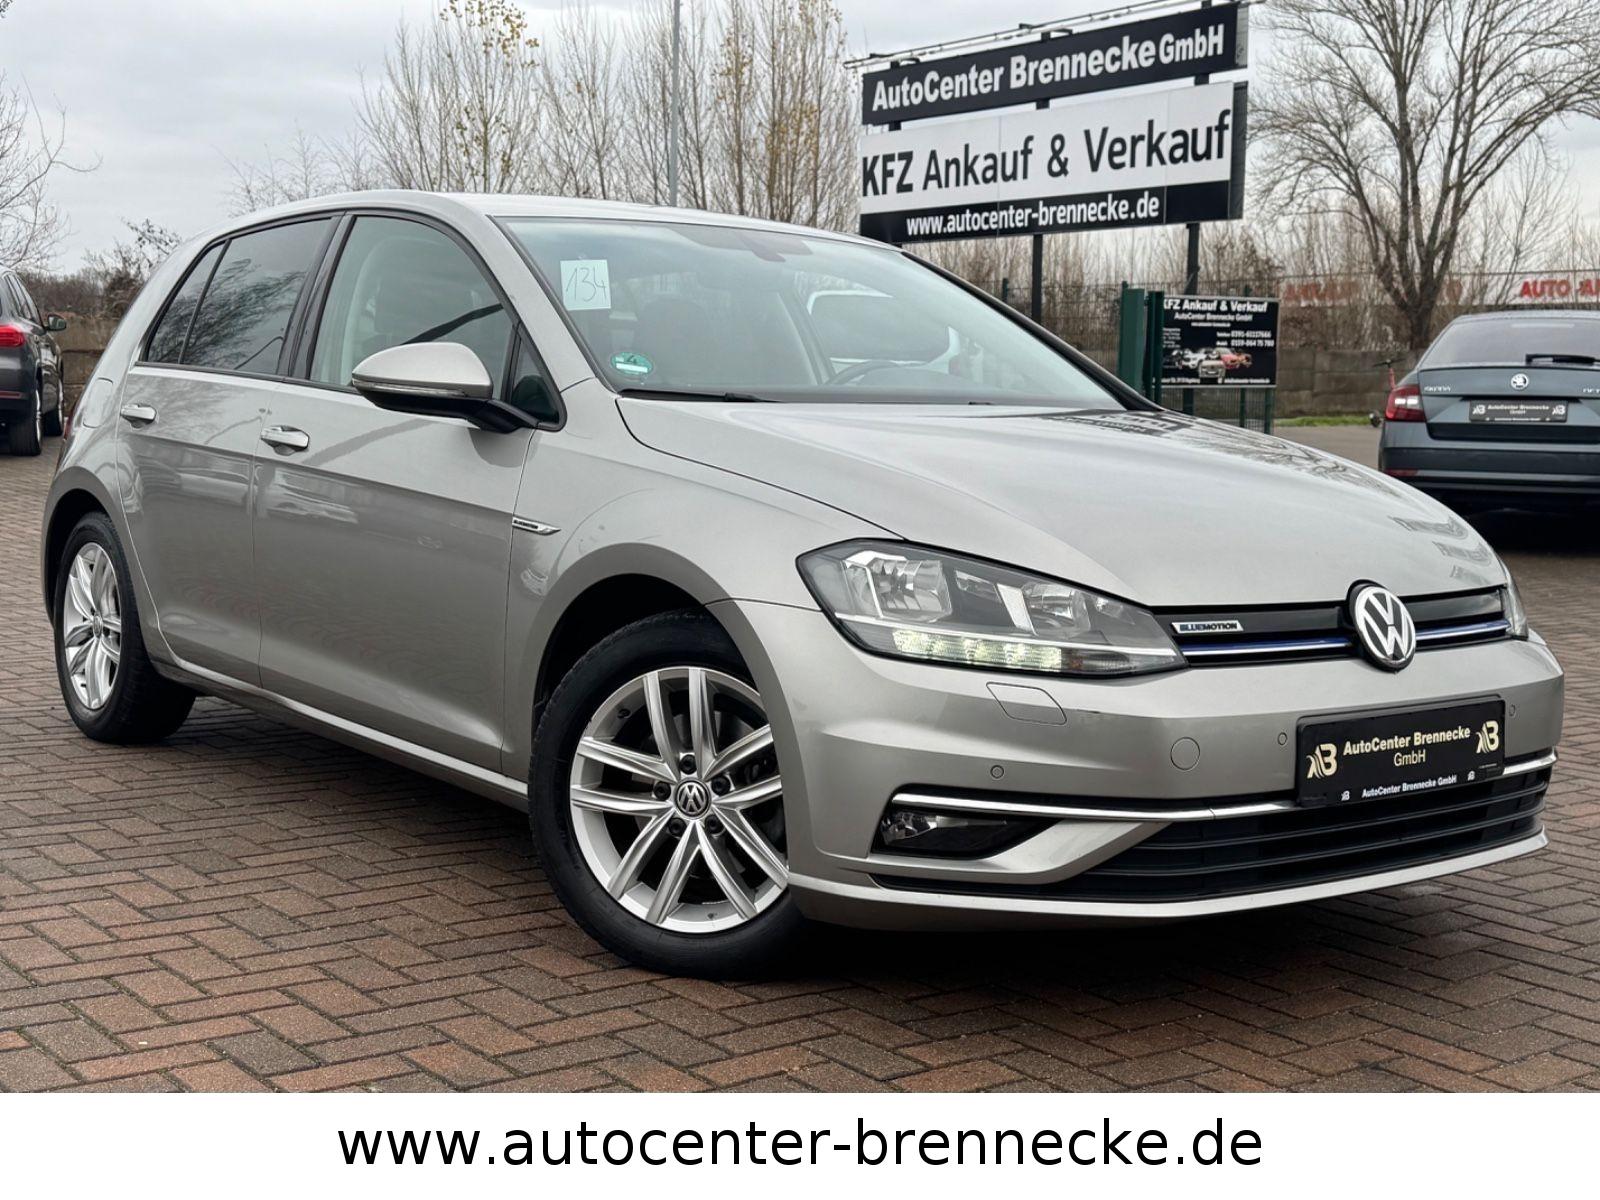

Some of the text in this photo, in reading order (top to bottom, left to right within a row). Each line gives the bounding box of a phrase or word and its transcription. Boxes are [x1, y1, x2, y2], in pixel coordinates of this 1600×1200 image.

[872, 23, 1225, 111] AutoCenter Brennecke GmbH
[862, 108, 1231, 198] KFZ Ankauf & Verkauf
[906, 191, 1160, 236] www.autocenter-brennecke.de
[566, 266, 607, 302] 134
[1519, 279, 1572, 298] AUTO
[1182, 299, 1218, 311] Ankauf
[1220, 301, 1228, 311] &
[1230, 301, 1268, 312] Verkauf
[1179, 622, 1238, 632] BLUEMOTION
[1343, 736, 1411, 756] AutoCenter
[1413, 726, 1471, 745] Brennecke
[1394, 750, 1426, 767] GmbH
[1362, 785, 1401, 799] AutoCenter
[1402, 779, 1437, 792] Brennecke
[1438, 774, 1458, 785] GmbH
